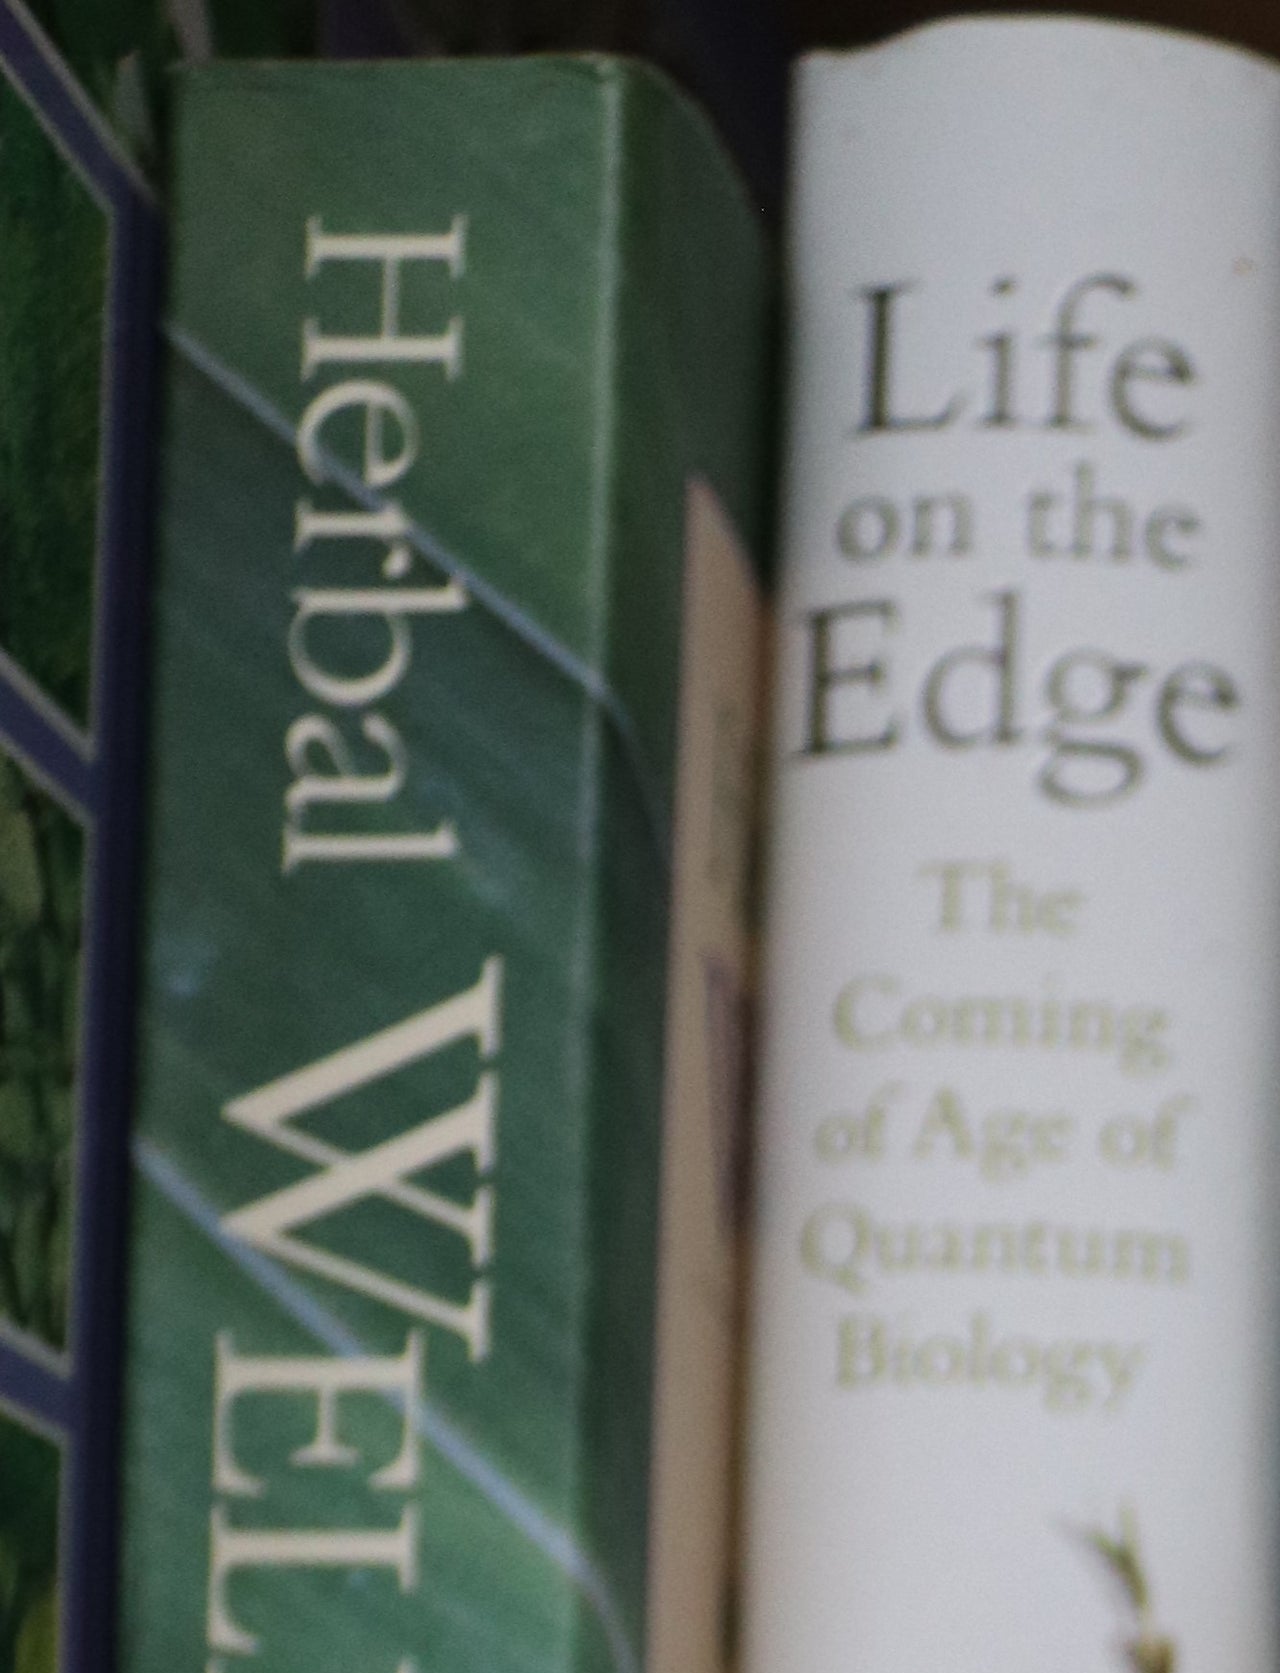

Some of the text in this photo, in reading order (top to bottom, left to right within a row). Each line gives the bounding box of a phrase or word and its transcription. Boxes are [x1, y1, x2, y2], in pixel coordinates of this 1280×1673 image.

[850, 274, 1197, 440] Life
[283, 214, 468, 868] Herbal
[834, 460, 1204, 572] on the
[790, 588, 1242, 808] Edge
[915, 857, 1082, 935] The
[830, 972, 1172, 1076] Coming
[813, 1088, 1196, 1183] of Age of
[798, 1207, 1192, 1294] Quantum
[833, 1314, 1152, 1412] Biology
